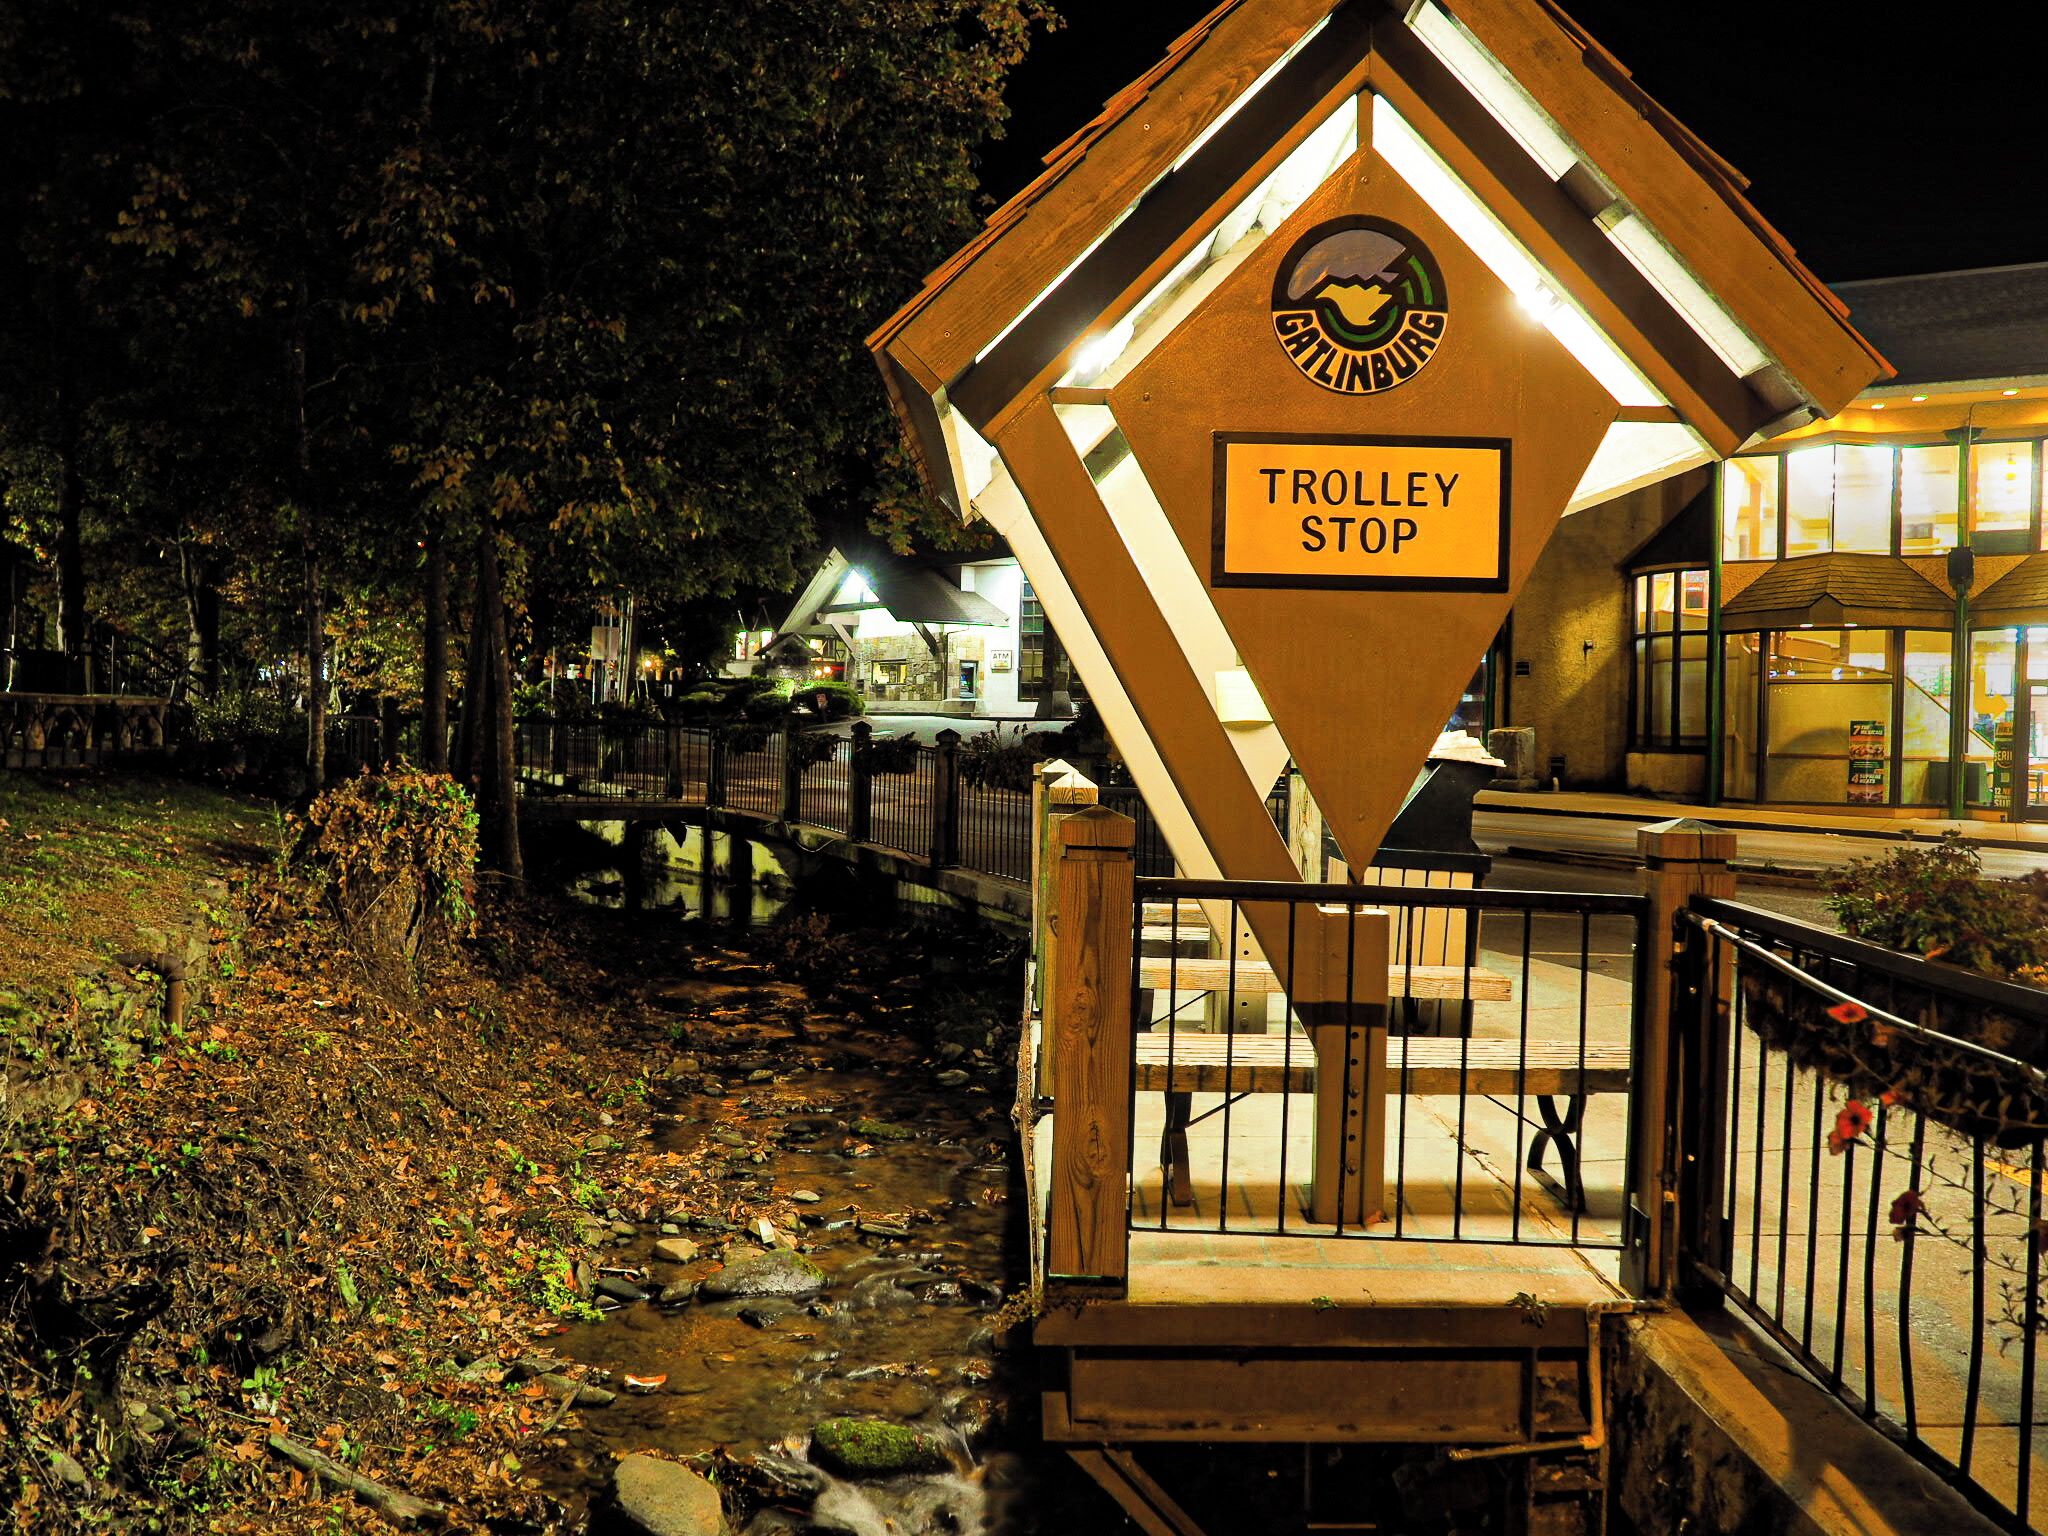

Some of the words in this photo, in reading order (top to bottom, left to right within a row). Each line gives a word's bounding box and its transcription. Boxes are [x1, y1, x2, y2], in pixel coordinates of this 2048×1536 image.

[1275, 313, 1446, 391] GATLINBURG
[1259, 468, 1460, 508] TROLLEY
[1300, 515, 1419, 554] STOP
